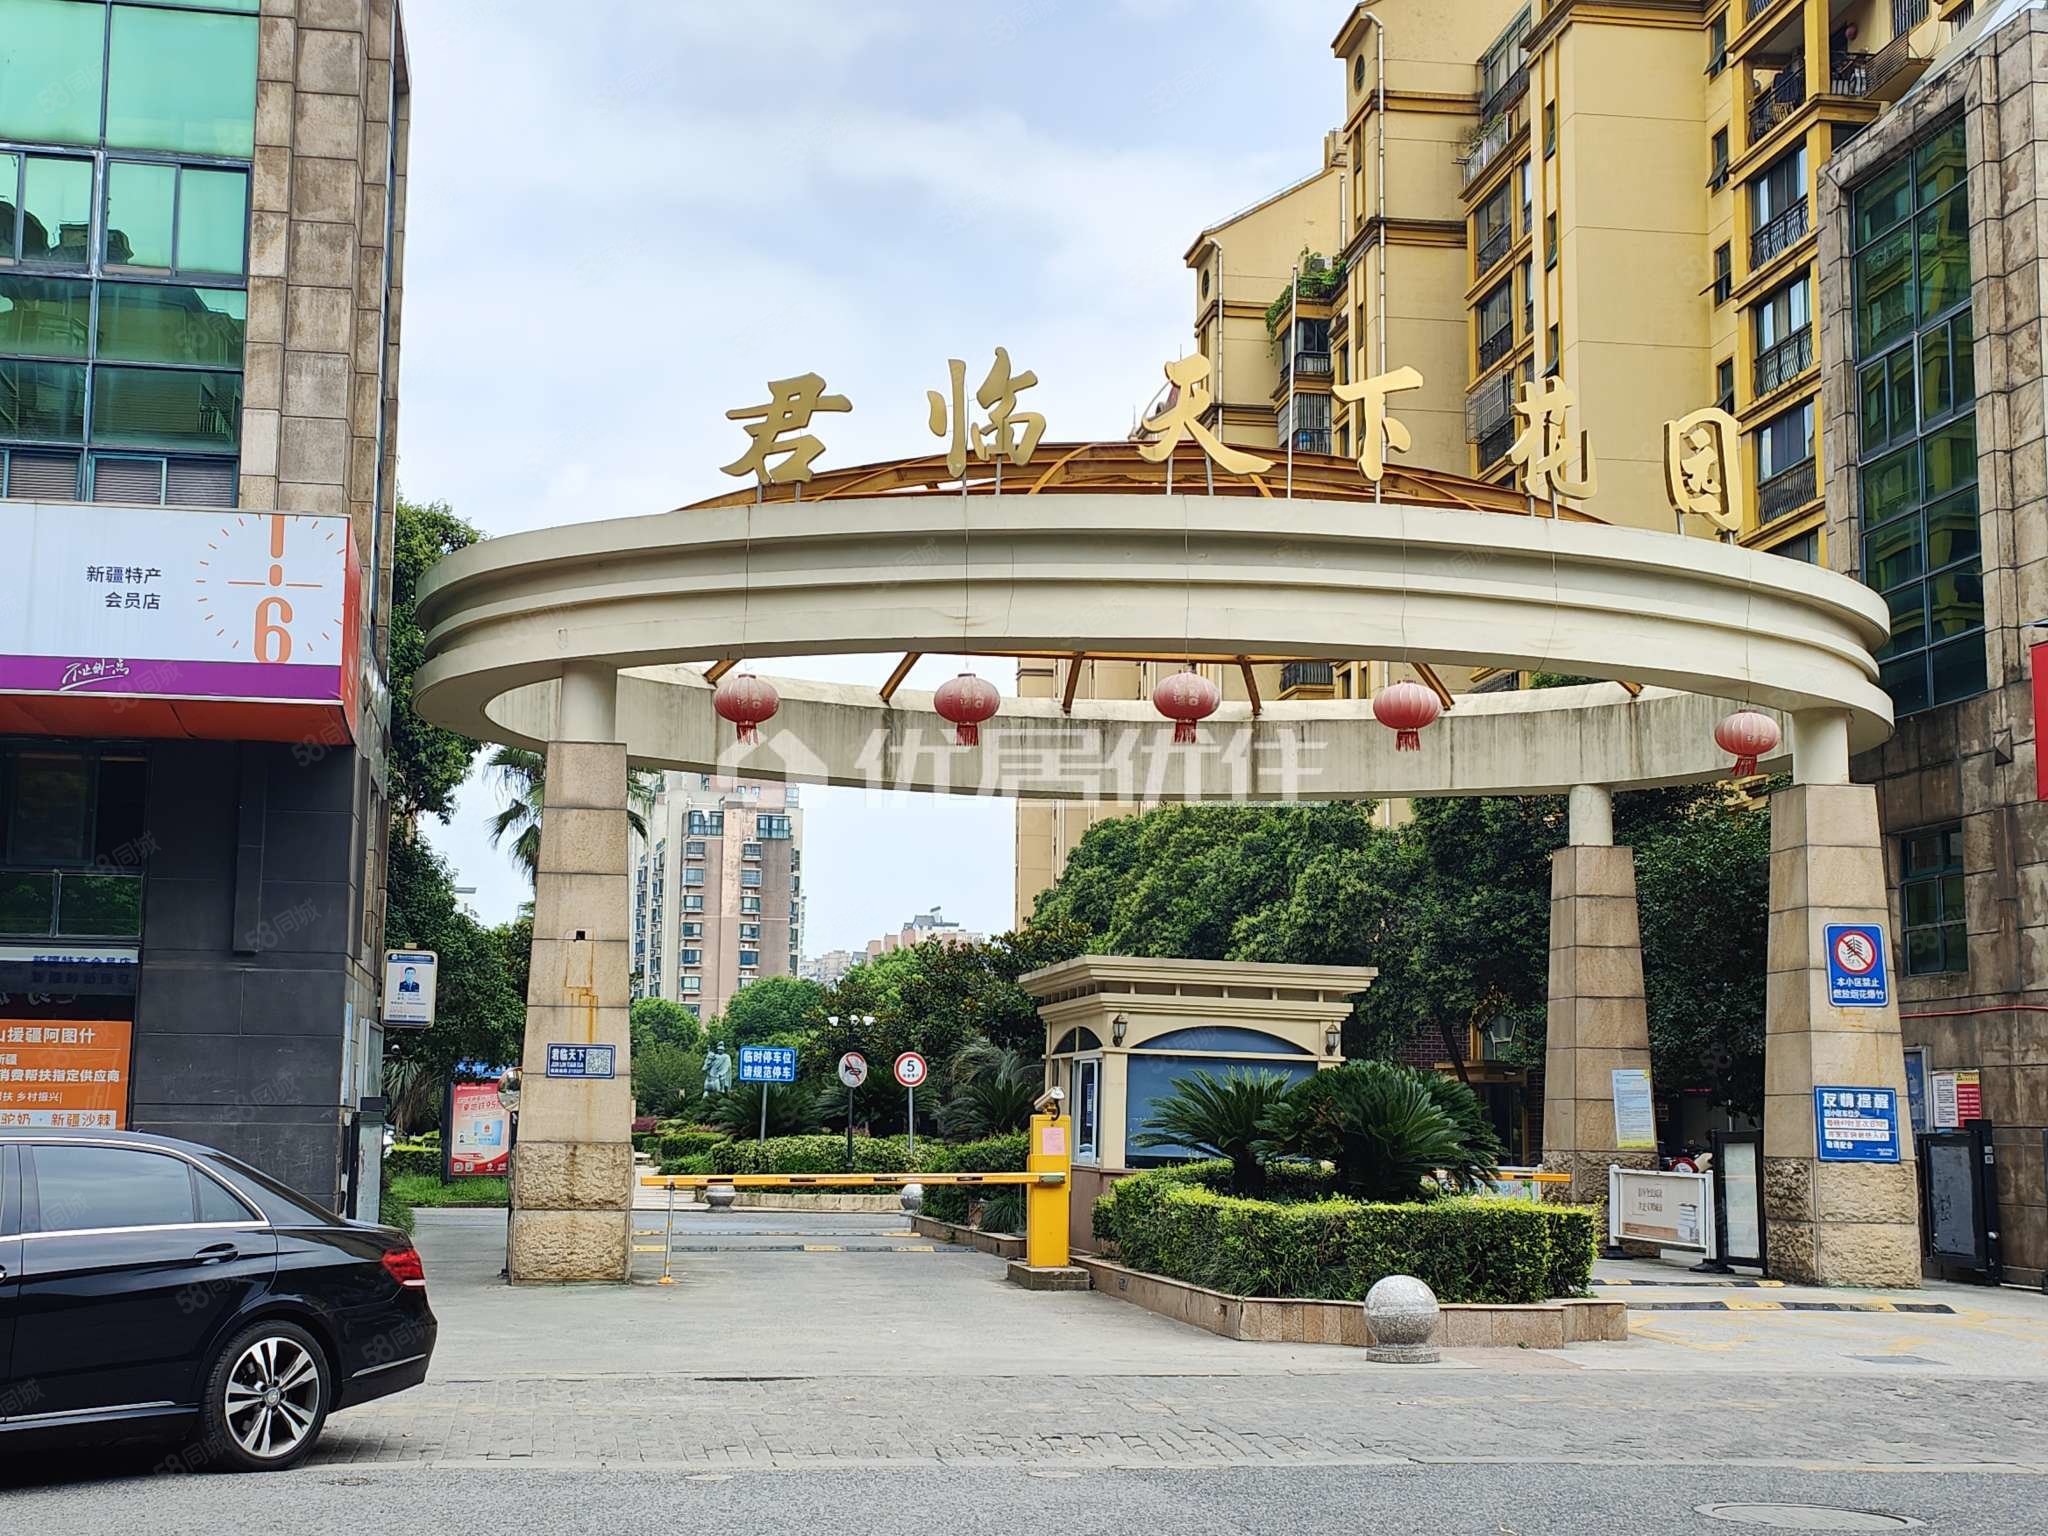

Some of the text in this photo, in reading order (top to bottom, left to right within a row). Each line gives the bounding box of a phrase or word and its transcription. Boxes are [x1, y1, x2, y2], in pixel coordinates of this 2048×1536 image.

[720, 346, 1742, 531] 君临天下花园
[86, 566, 162, 584] 新疆特产
[105, 591, 161, 610] 会员店
[551, 1048, 585, 1061] 君临天下
[743, 1050, 792, 1064] 临时停车位
[743, 1066, 792, 1079] 请规范停车
[906, 1060, 915, 1072] 5
[1823, 1092, 1889, 1109] 友情提醒
[51, 1113, 111, 1127] 新疆沙棘
